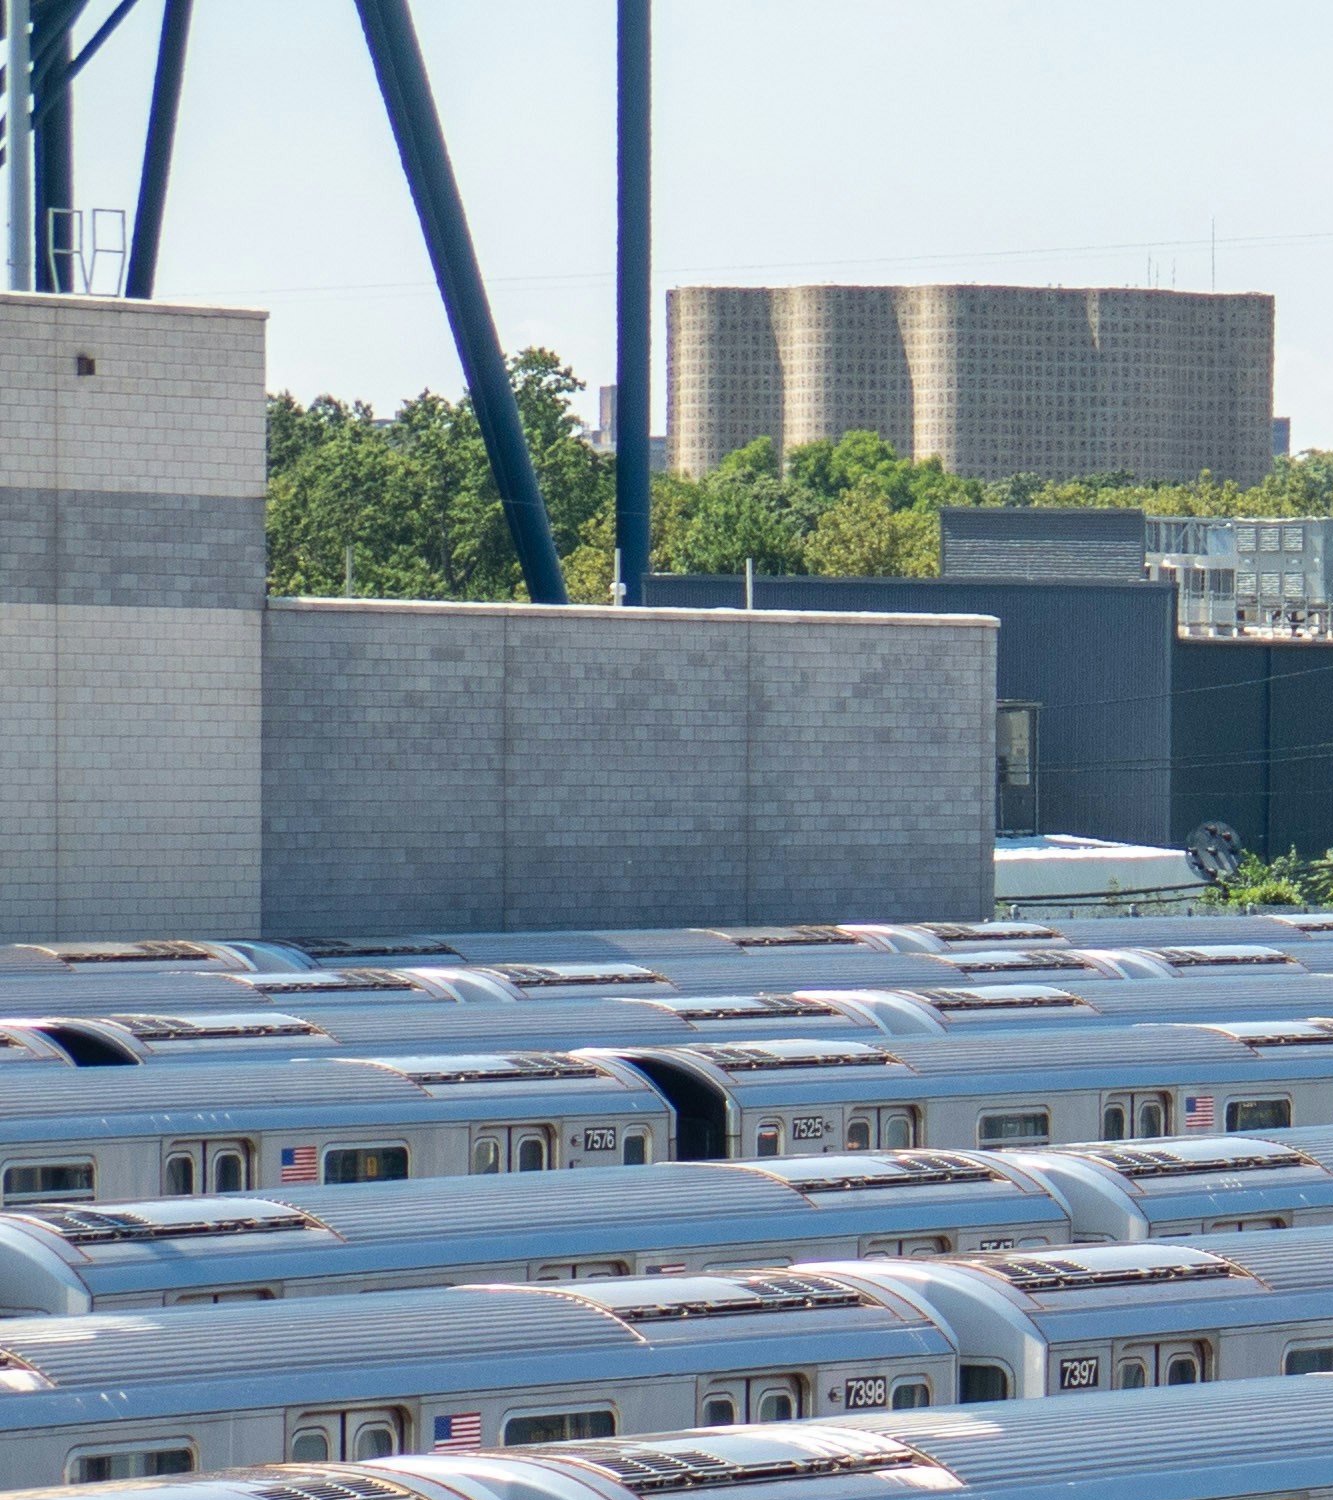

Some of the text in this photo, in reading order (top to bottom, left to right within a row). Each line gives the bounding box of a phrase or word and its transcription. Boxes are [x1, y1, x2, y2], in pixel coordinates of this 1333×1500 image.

[585, 1127, 615, 1150] 7576
[793, 1116, 823, 1139] 7525
[1062, 1358, 1097, 1387] 7397
[847, 1378, 886, 1408] 7398
